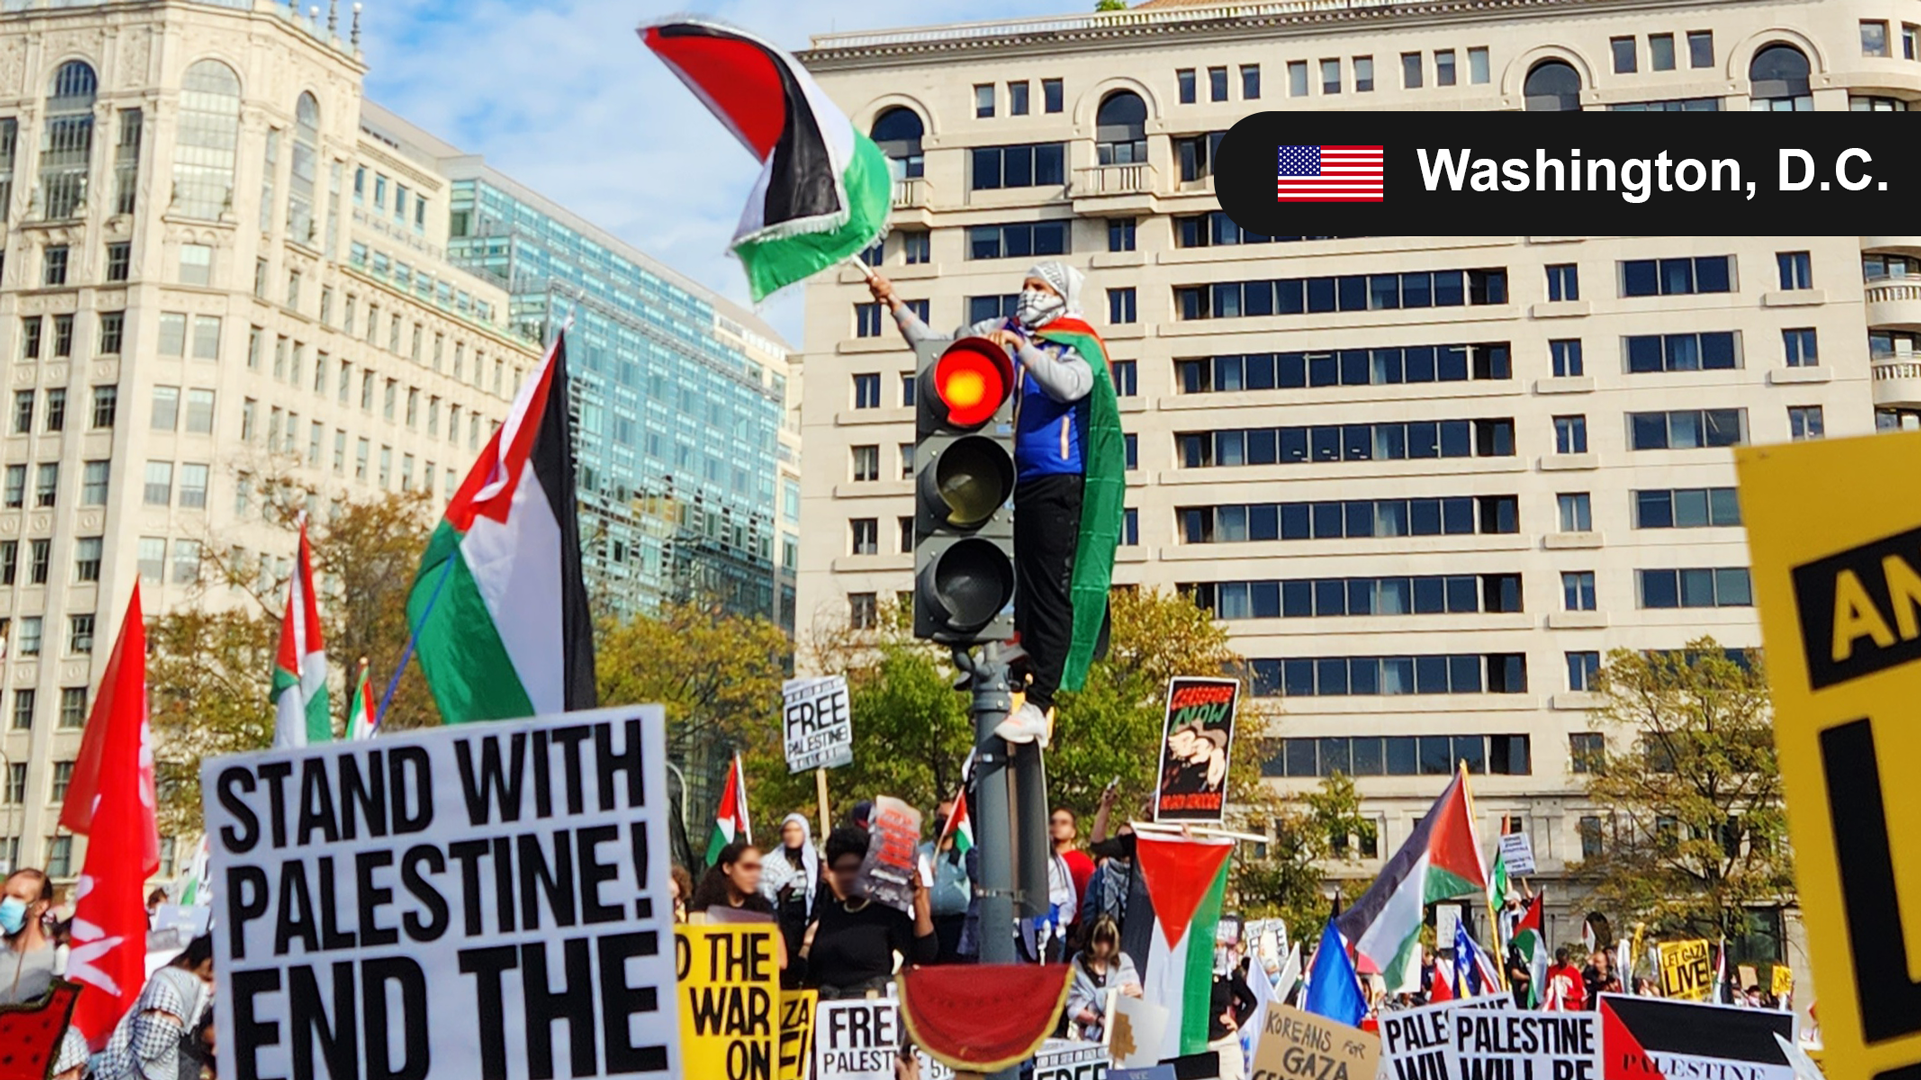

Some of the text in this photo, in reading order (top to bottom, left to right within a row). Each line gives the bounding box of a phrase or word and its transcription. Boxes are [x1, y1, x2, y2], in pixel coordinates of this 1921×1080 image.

[786, 690, 847, 740] FREE
[1169, 703, 1230, 734] NOW
[216, 718, 646, 854] STAND WITH
[226, 820, 653, 960] PALESTINE!
[703, 932, 771, 982] THE
[1662, 943, 1708, 969] LET GAZA
[230, 930, 669, 1080] END THE
[689, 986, 771, 1036] WAR
[780, 997, 809, 1030] ZA
[1265, 1010, 1366, 1060] KOREANS FOR
[1456, 1015, 1595, 1055] PALESTINE
[726, 1040, 771, 1080] ON
[823, 1050, 899, 1075] PALEST
[1282, 1046, 1349, 1080] GAZA
[1623, 1052, 1766, 1080] PALESTINE
